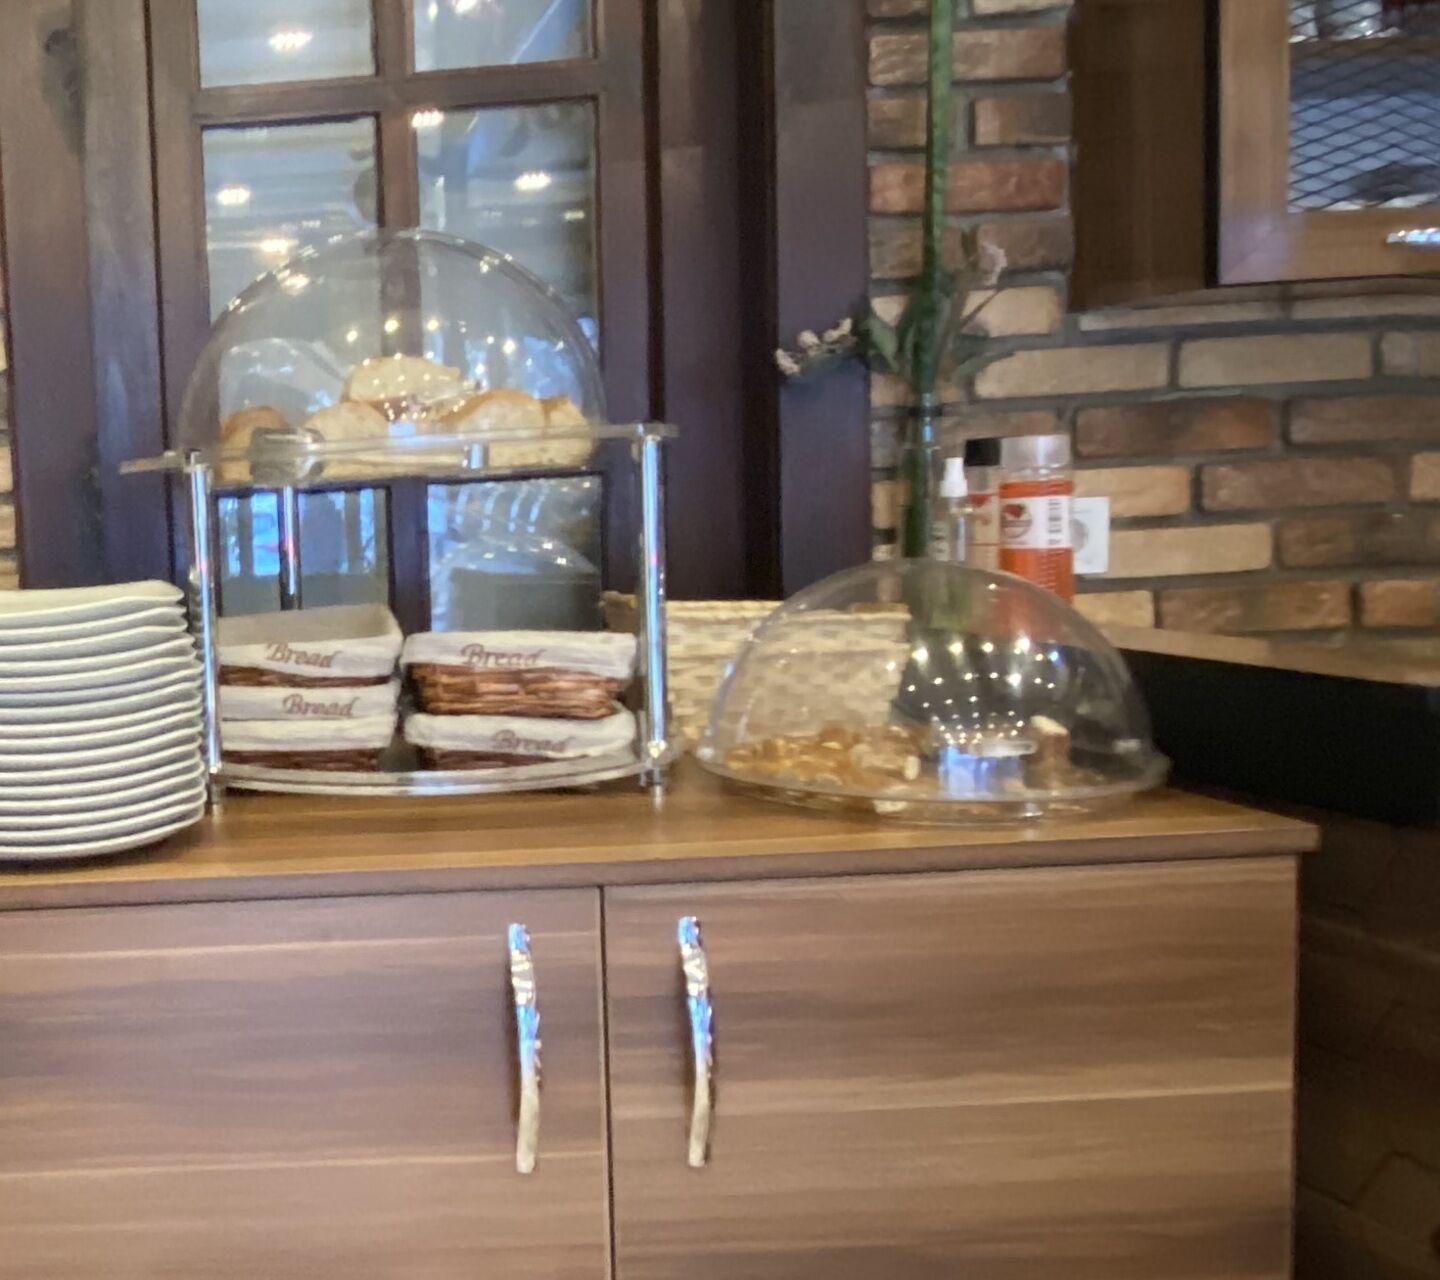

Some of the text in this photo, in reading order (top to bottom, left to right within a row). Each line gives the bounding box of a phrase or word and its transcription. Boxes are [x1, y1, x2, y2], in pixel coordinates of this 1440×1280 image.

[265, 642, 342, 668] Bread
[461, 643, 546, 666] Bread
[282, 693, 360, 717] Bread
